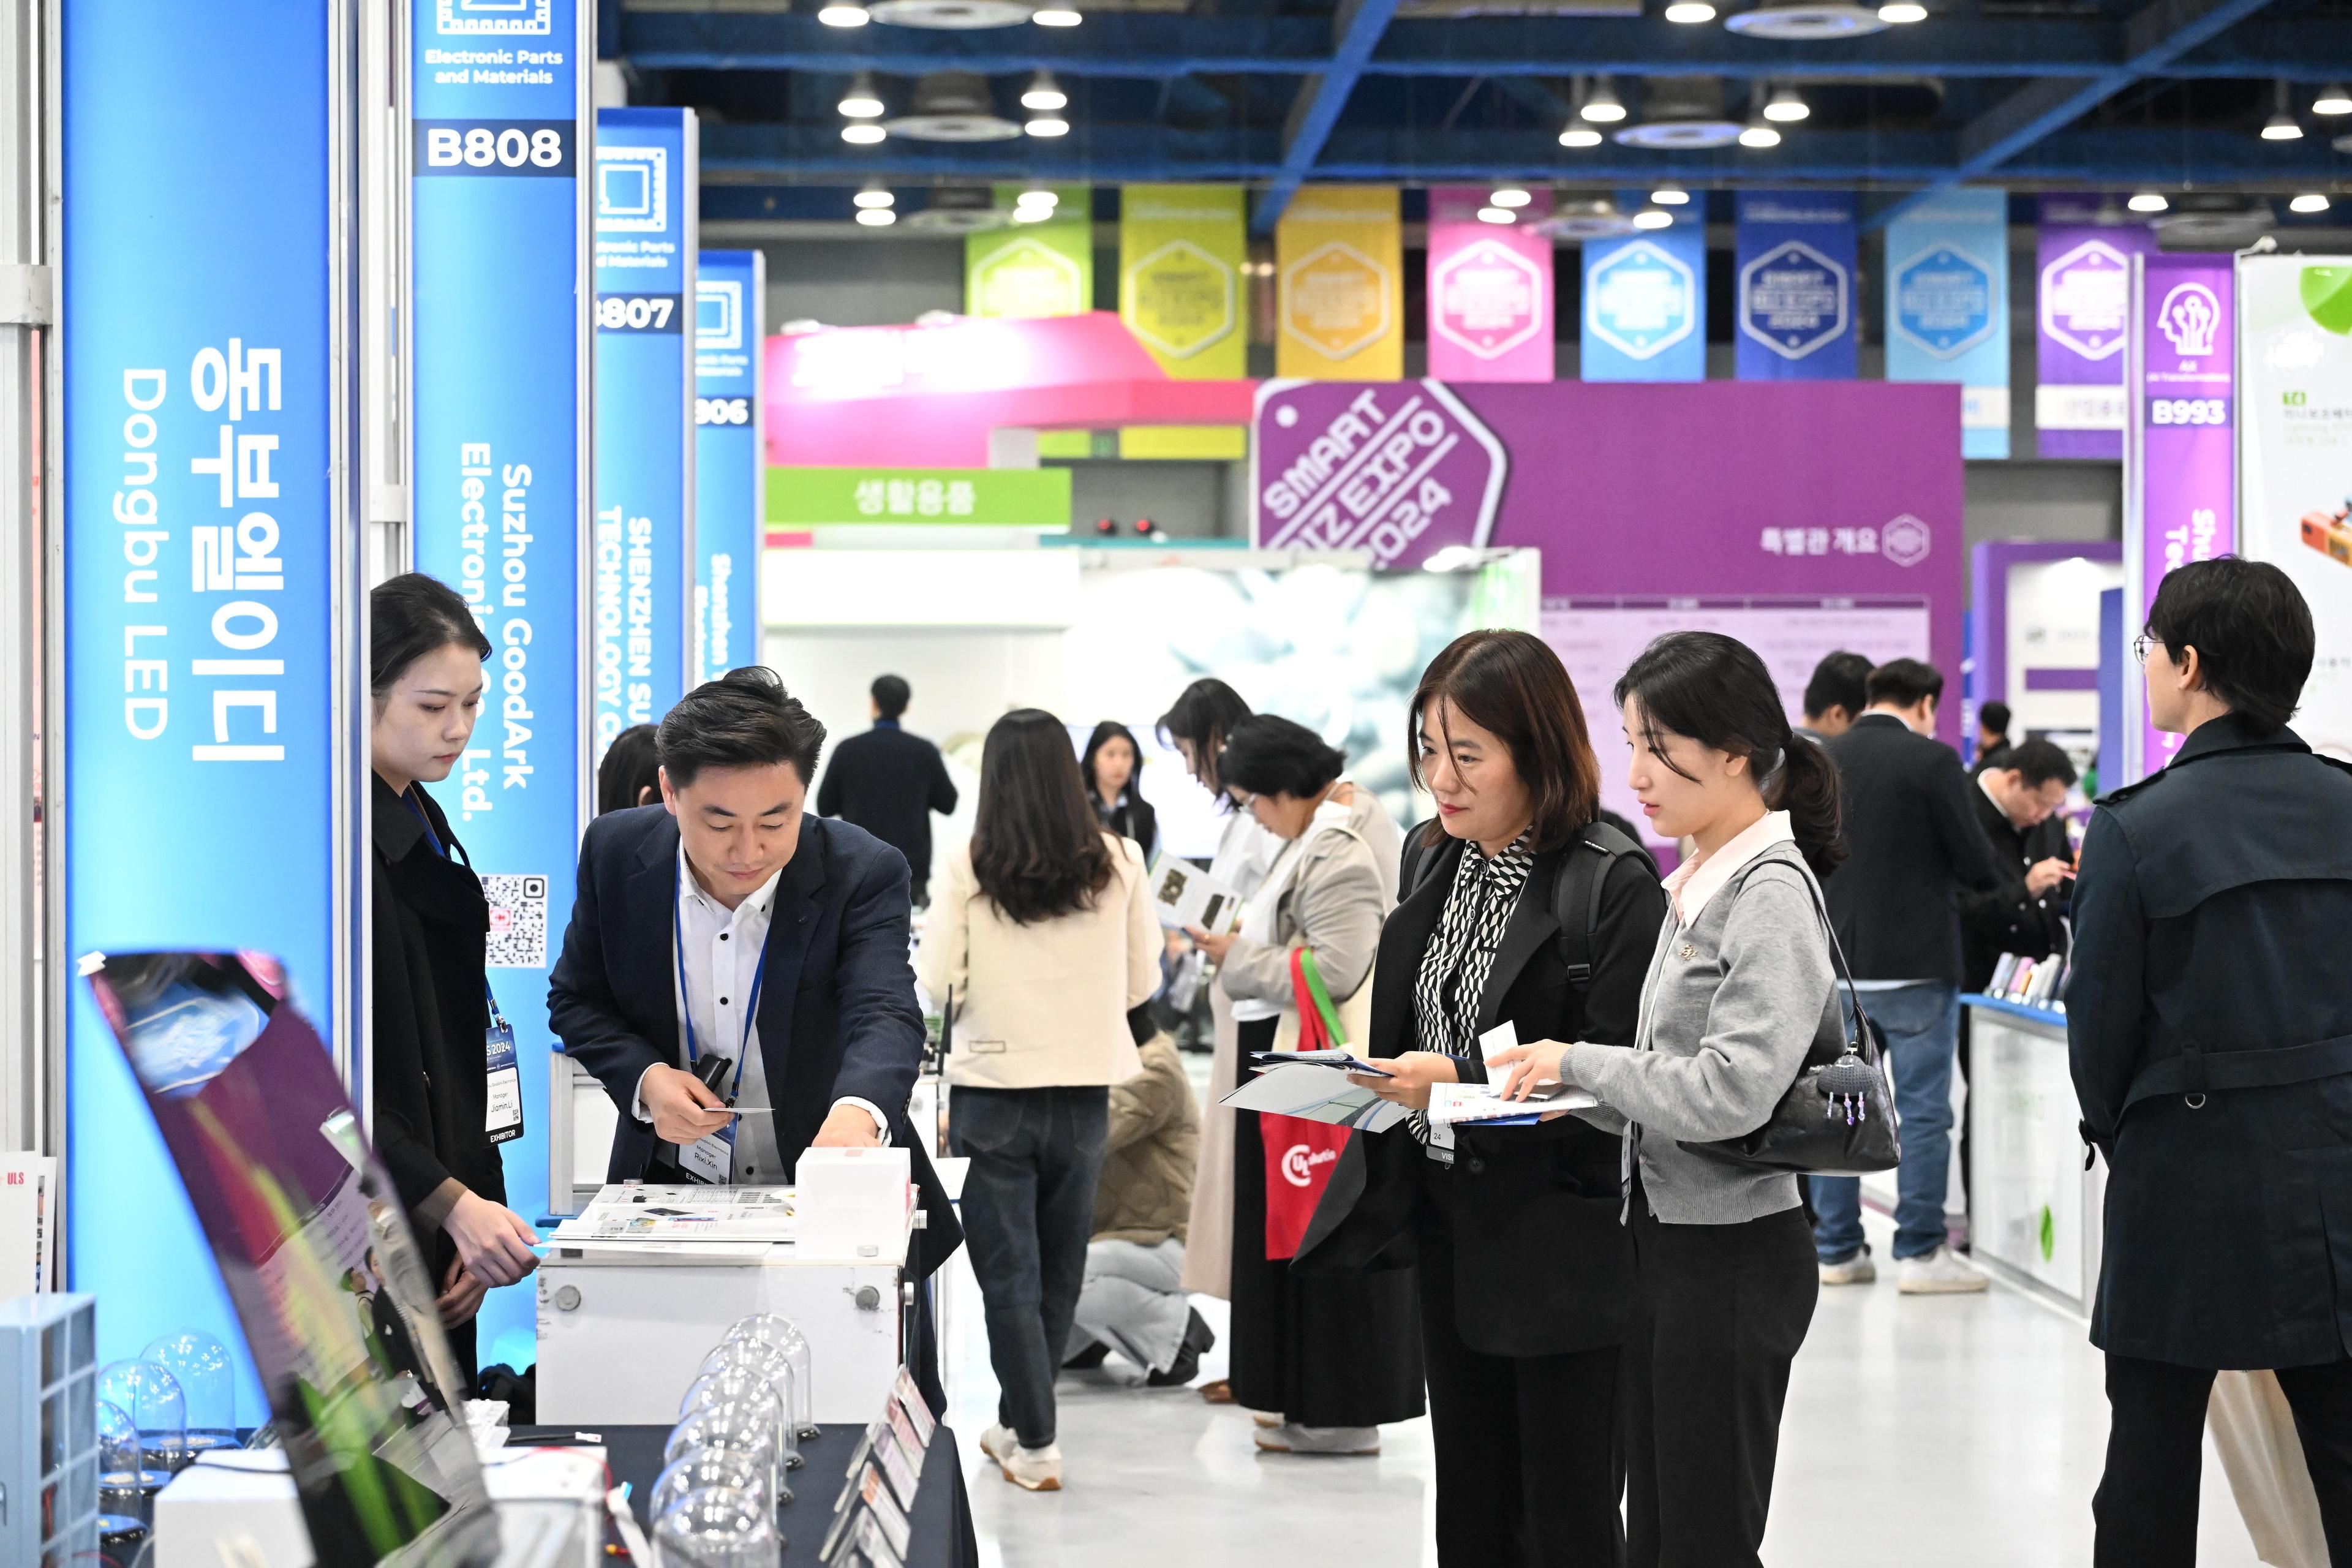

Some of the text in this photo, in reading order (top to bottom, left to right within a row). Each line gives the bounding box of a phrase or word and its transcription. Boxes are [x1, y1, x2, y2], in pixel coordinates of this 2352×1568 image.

[425, 49, 564, 64] Electronic Parts
[435, 69, 553, 84] and Materials
[428, 129, 562, 168] B808
[2152, 399, 2227, 425] B993
[1262, 388, 1386, 519] SMART
[1336, 409, 1445, 519] EXPO
[113, 369, 170, 741] Dongbu LED
[190, 337, 285, 761] 동부엘이디
[597, 504, 622, 708] TECHNOLOGY
[628, 517, 652, 725] SHENZHEN SU
[502, 463, 535, 790] Suzhou GoodArk
[462, 749, 493, 822] Ltd.
[491, 1041, 511, 1055] 2024
[490, 1129, 516, 1143] EXHIBITOR
[696, 1145, 716, 1159] Manager
[694, 1152, 718, 1170] Rixi.Xin
[7, 1172, 24, 1185] ULS
[686, 1172, 707, 1185] EXHIB
